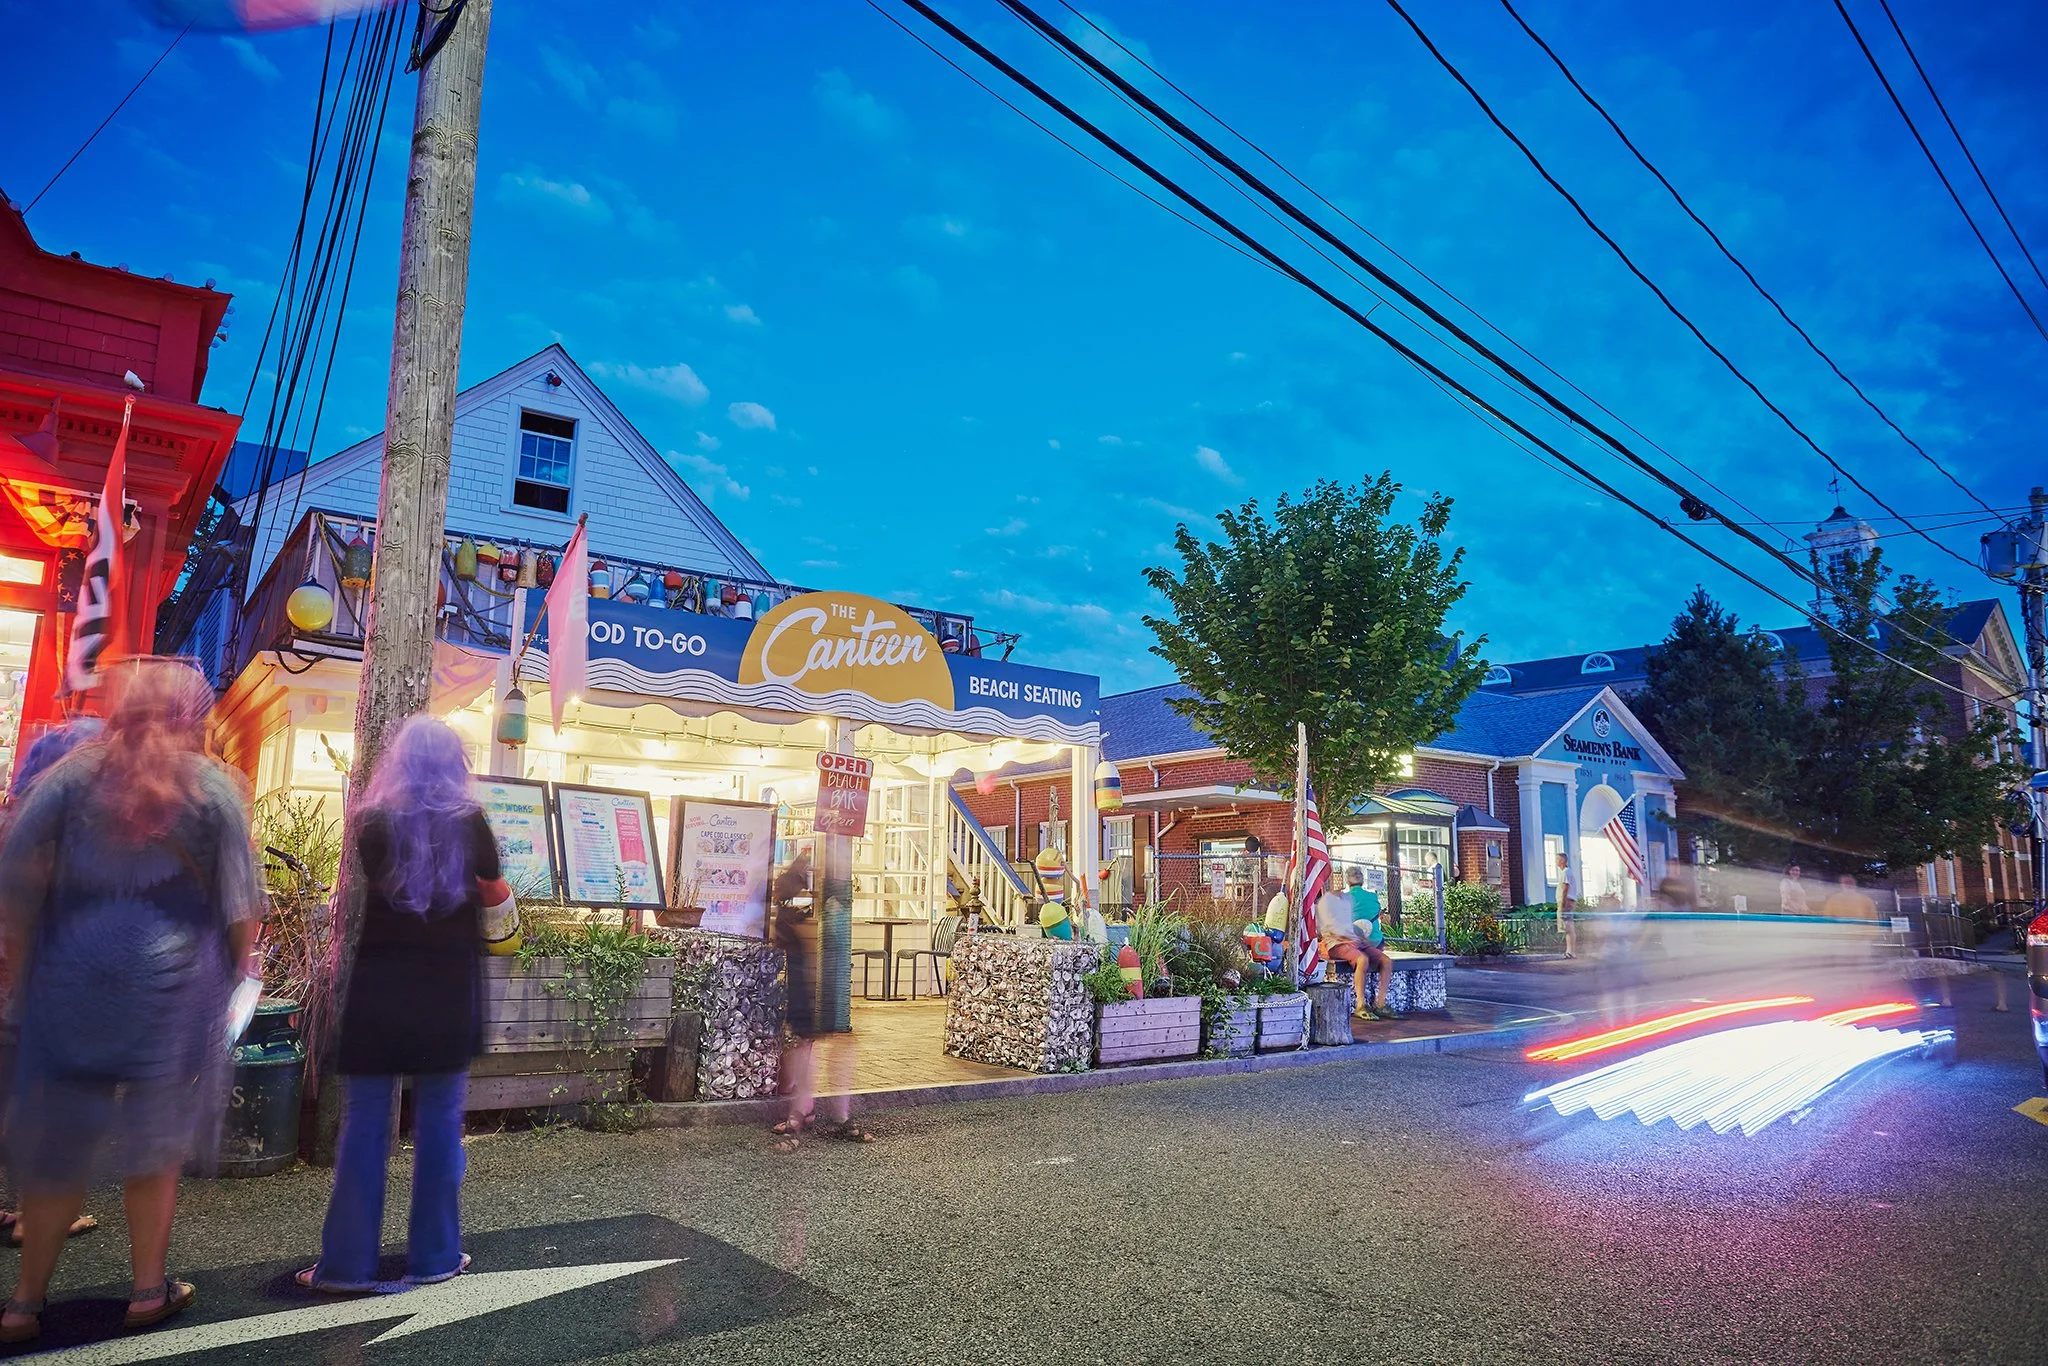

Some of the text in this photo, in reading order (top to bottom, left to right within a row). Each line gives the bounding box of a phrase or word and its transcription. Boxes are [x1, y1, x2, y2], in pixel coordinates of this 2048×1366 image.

[830, 603, 857, 620] THE
[633, 626, 707, 656] TO-GO
[761, 607, 927, 684] Canteen
[969, 676, 1082, 709] BEACH SEATING
[1563, 733, 1642, 761] SEAMEN'S BANK
[820, 754, 867, 774] OPEN
[1578, 755, 1606, 764] MEMBER
[827, 771, 864, 790] BEACH
[505, 803, 534, 813] WORKS
[830, 789, 859, 812] BAR
[709, 813, 738, 827] Canteen
[820, 813, 855, 831] Open
[700, 830, 747, 841] CAPE COD CLASSICS
